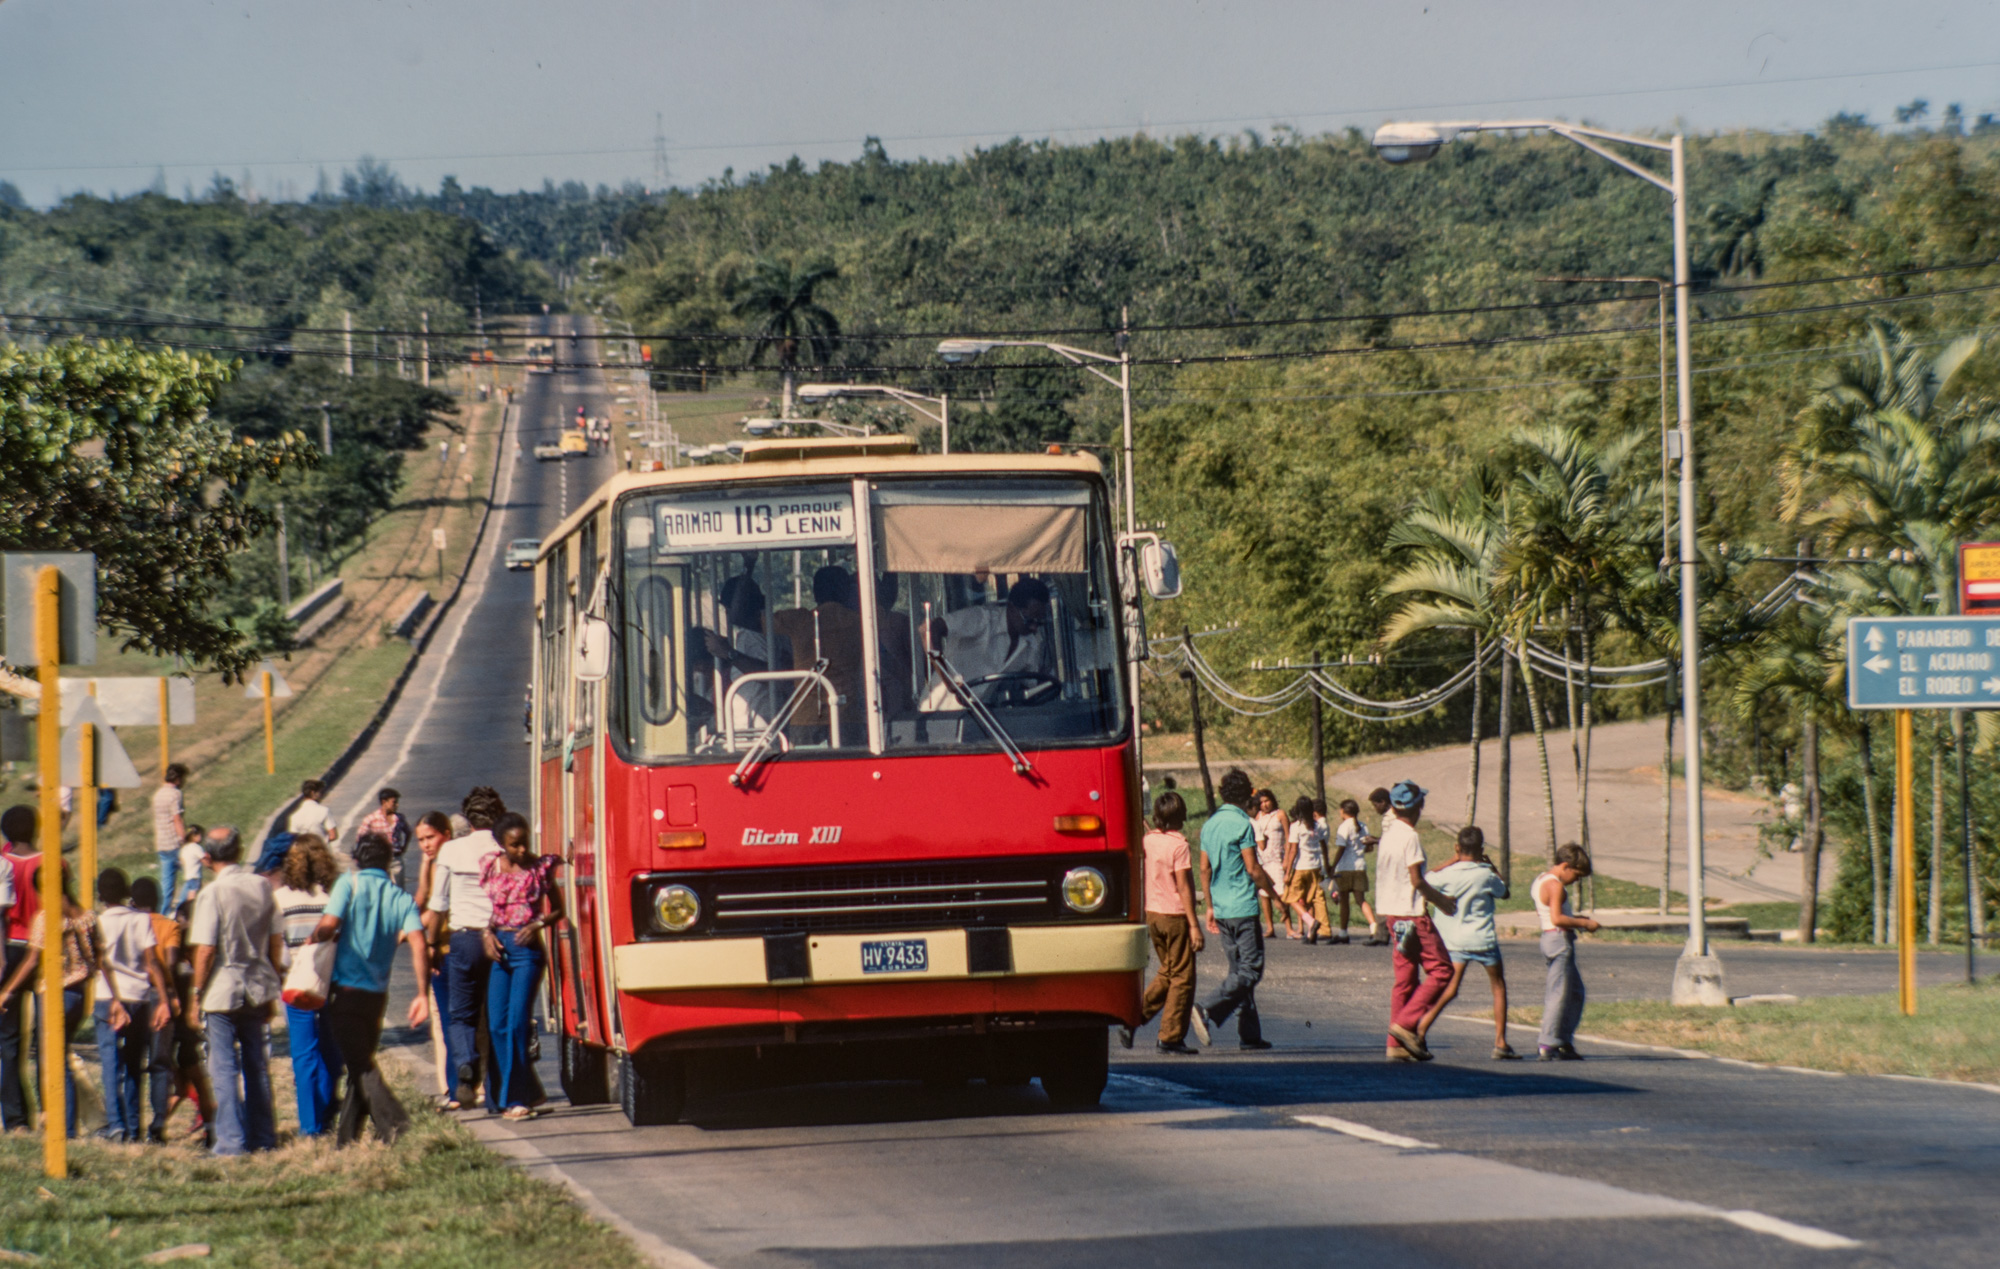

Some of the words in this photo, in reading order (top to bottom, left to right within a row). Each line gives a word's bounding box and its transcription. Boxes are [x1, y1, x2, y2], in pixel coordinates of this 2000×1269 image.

[779, 501, 843, 515] PARQUE
[735, 504, 772, 535] 113
[785, 515, 841, 534] LENIN
[1896, 629, 1973, 647] PARADERO
[1900, 653, 1918, 672] EL
[1928, 653, 1991, 671] ACUARIO
[1899, 677, 1918, 696] EL
[1925, 676, 1974, 695] RODEO
[808, 826, 842, 844] XIII
